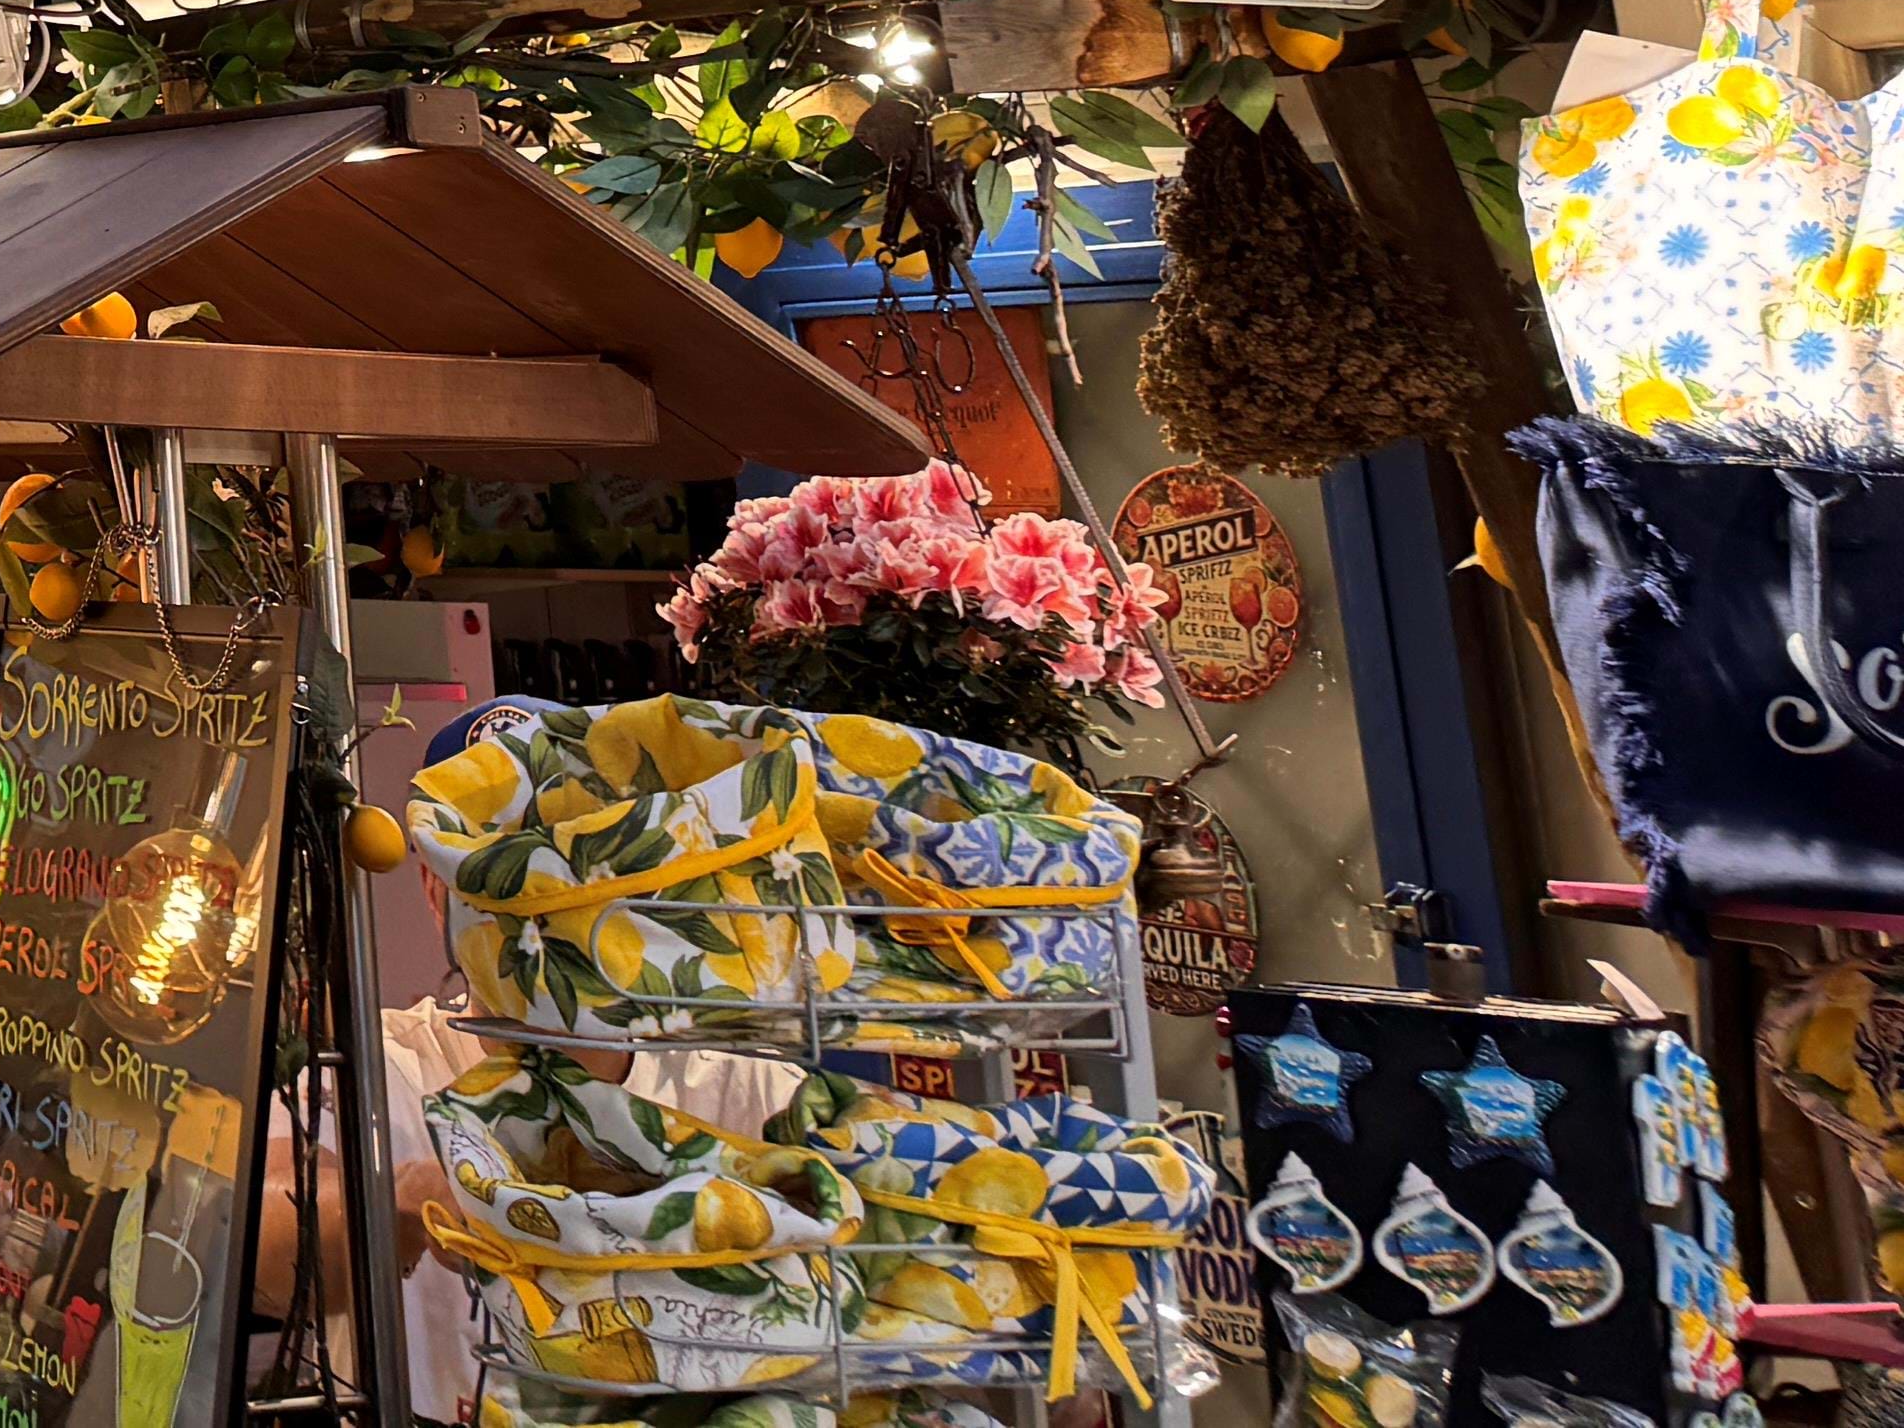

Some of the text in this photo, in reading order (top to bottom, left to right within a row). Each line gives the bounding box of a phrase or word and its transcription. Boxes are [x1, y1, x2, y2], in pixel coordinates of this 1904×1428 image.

[1142, 517, 1255, 566] APEROL
[0, 645, 268, 747] SORRENTO SPRITZ
[51, 763, 149, 826] SPRITZ
[1142, 924, 1229, 973] QUILA
[1142, 962, 1222, 992] RVED HERE
[90, 1036, 190, 1112] SPRITZ
[31, 1096, 140, 1173] SPRITZ
[1201, 1320, 1258, 1346] SWED
